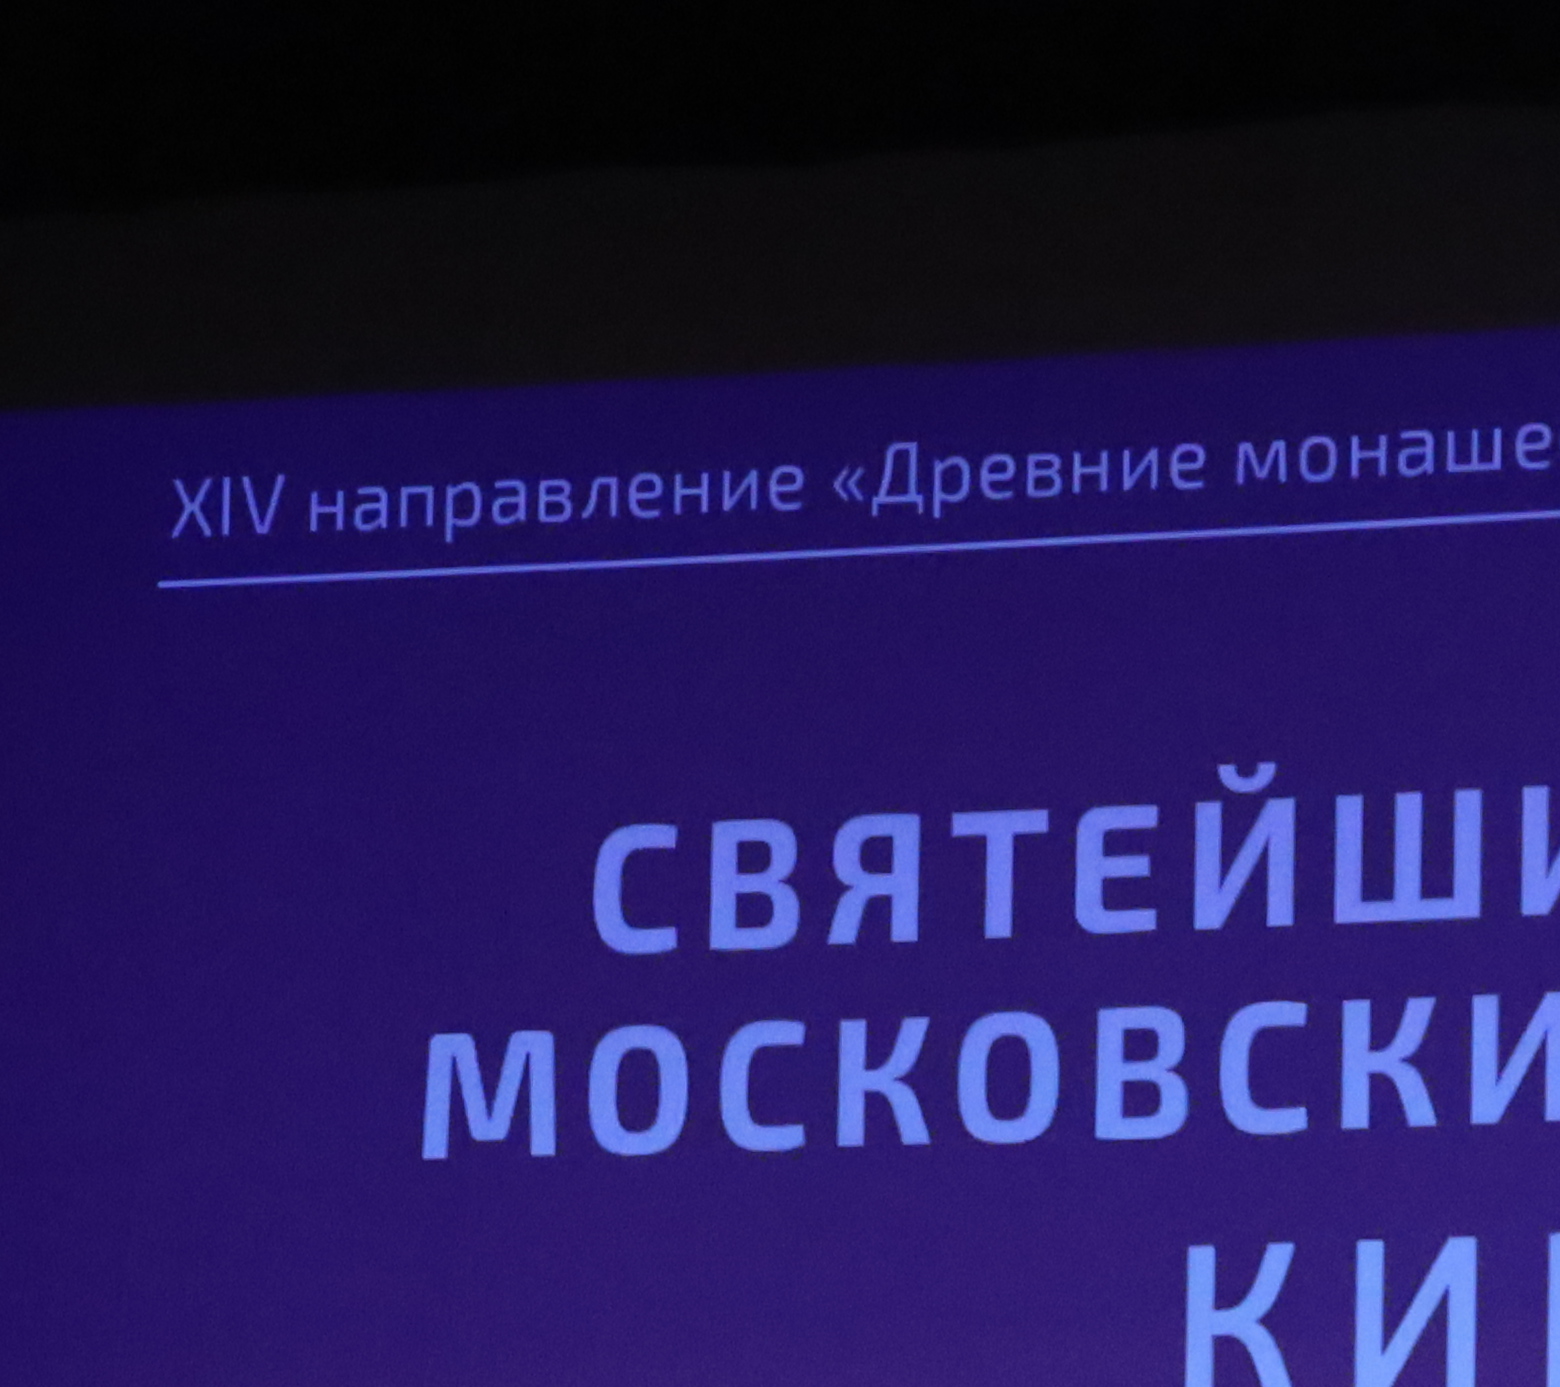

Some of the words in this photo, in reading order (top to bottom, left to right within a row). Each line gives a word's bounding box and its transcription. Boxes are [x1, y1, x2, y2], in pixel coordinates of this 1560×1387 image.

[172, 475, 284, 538] XIV
[310, 465, 805, 543] направление
[833, 441, 1207, 518] «Древние
